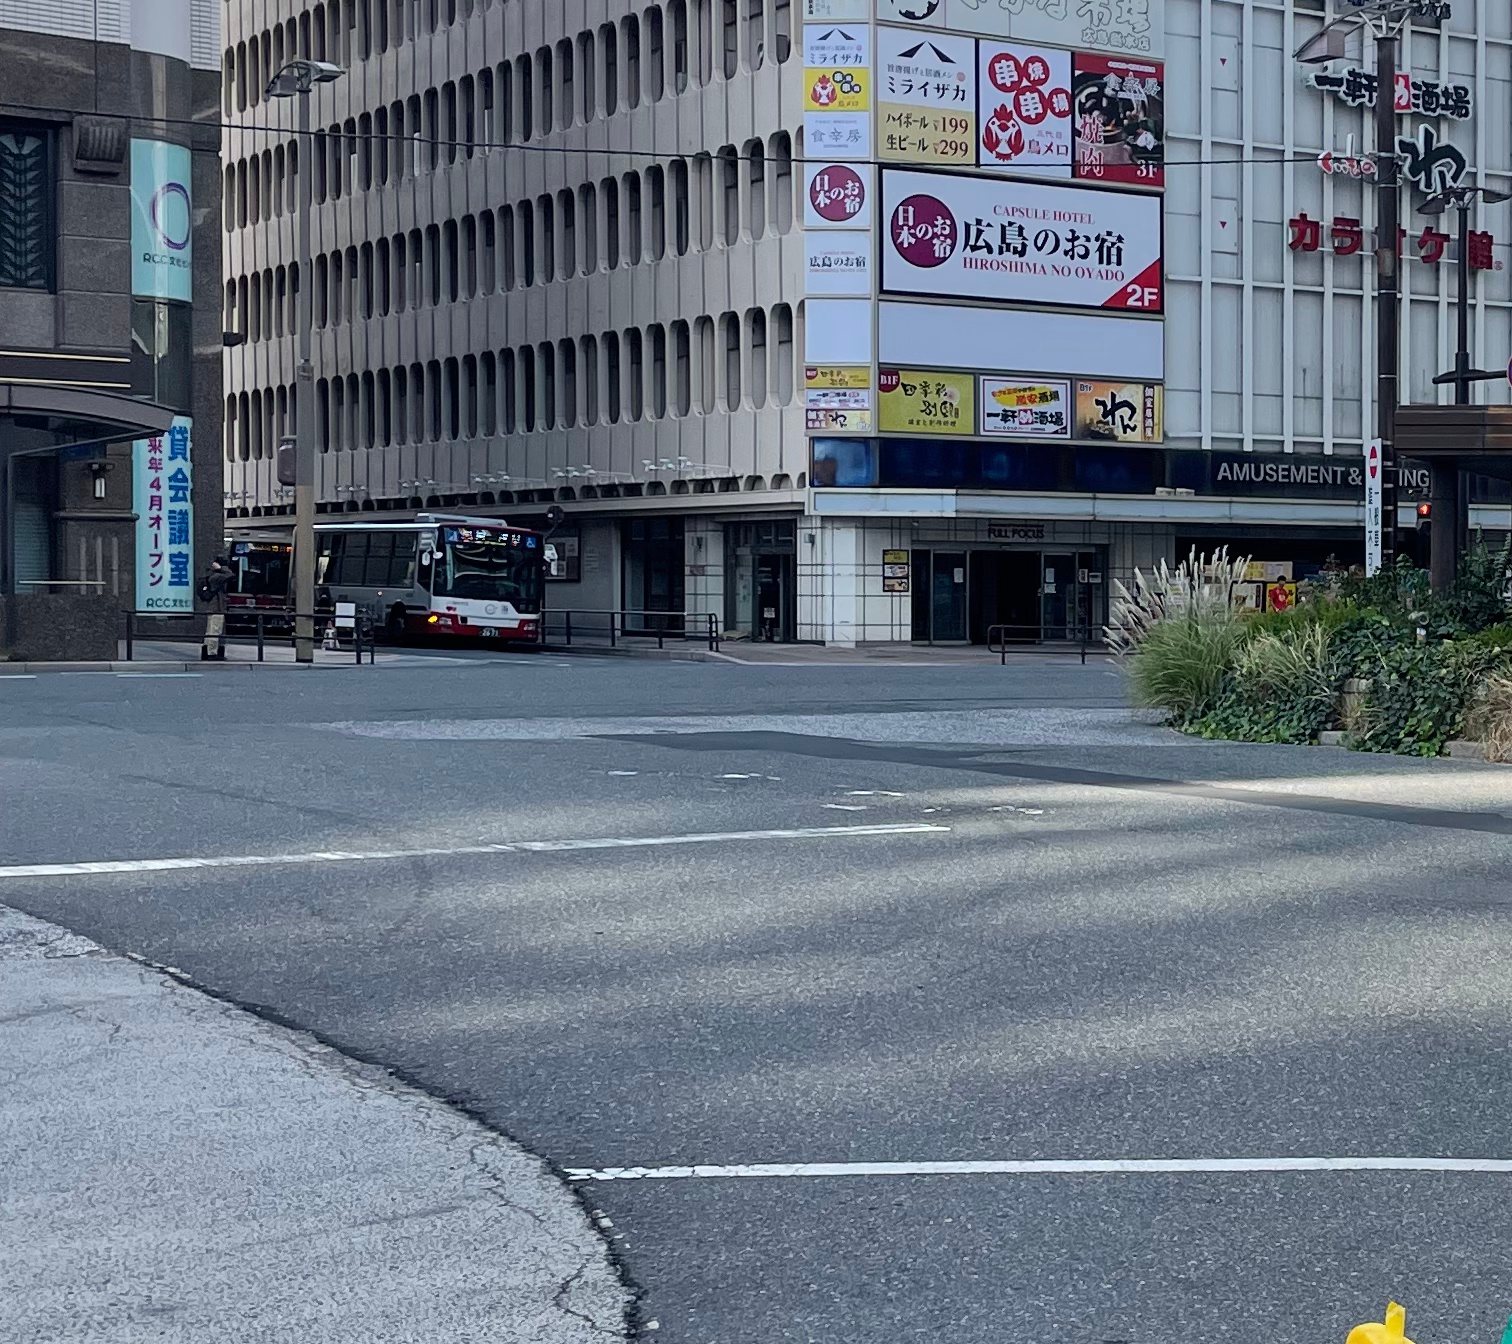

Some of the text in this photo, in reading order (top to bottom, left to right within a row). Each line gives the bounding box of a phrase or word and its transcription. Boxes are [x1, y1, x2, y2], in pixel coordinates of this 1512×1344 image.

[810, 53, 862, 64] ミライザカ
[887, 76, 966, 101] ミライザカ
[886, 112, 929, 129] ハイボール
[886, 134, 929, 152] 生ビール
[1027, 140, 1069, 156] 鳥メロ
[1080, 114, 1104, 177] 焼肉
[1137, 161, 1158, 178] 3F
[993, 205, 1095, 225] CAPSULE HOTEL
[962, 218, 1124, 266] 広島のお宿
[1289, 213, 1493, 269] カラケ館
[809, 256, 866, 268] 広島のお宿
[963, 257, 1124, 282] HIROSHIMA NO OYADO
[1126, 284, 1158, 306] 2F
[880, 375, 898, 385] B1F
[987, 408, 1064, 426] 一軒め酒場
[1217, 463, 1430, 487] AMUSEMENT & ING
[148, 437, 163, 587] 来年4月オープン
[168, 426, 190, 587] 貸会議室
